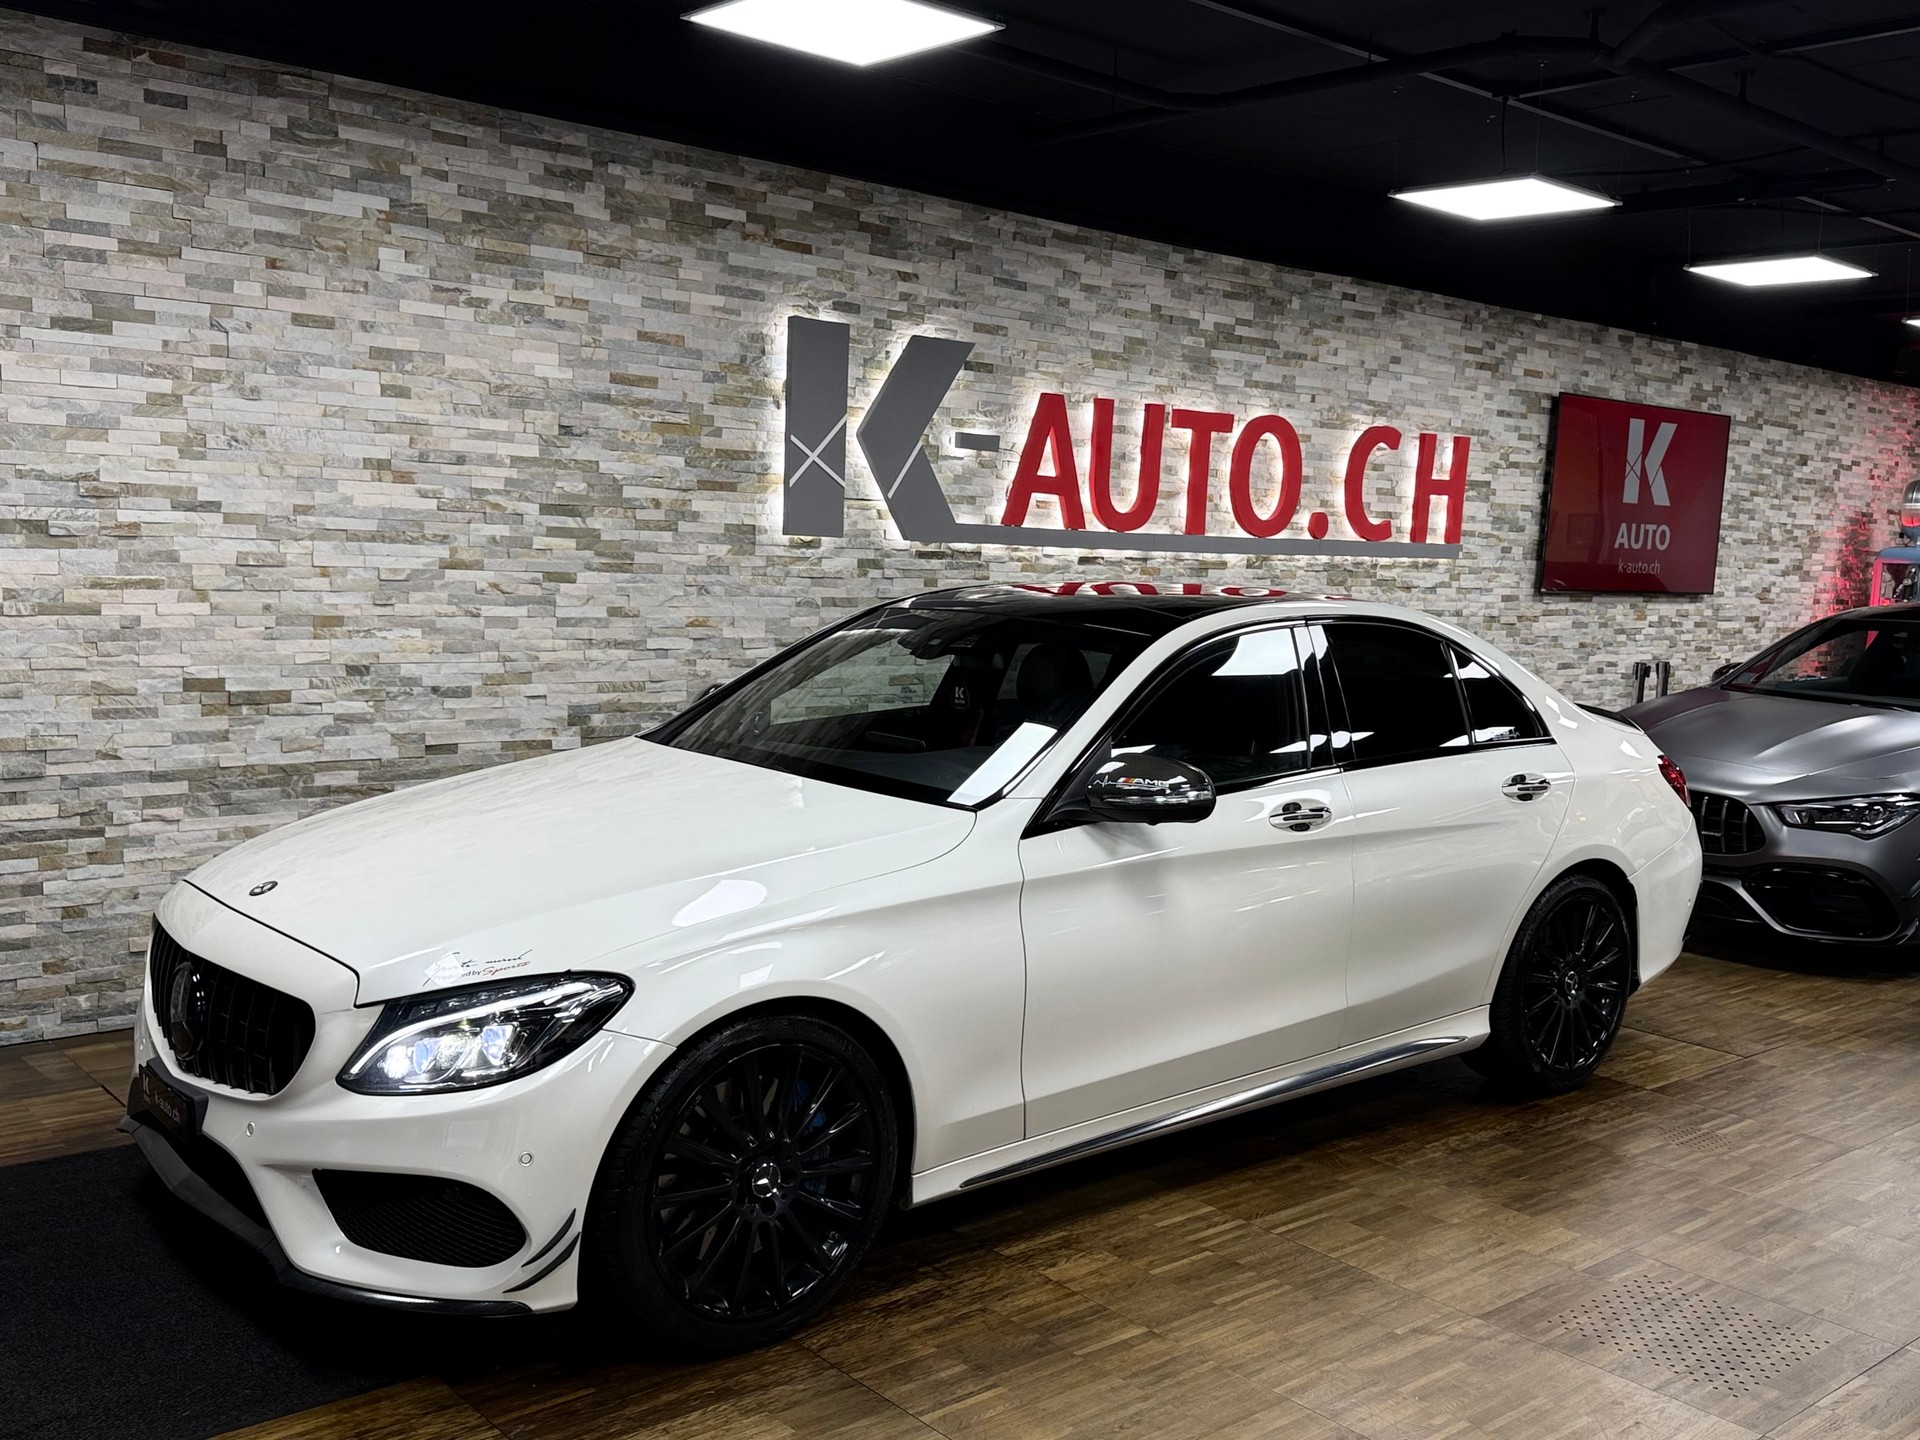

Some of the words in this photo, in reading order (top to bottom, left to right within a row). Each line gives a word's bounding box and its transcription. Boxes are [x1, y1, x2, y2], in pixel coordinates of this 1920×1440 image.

[1624, 418, 1677, 506] K
[1614, 522, 1671, 551] AUTO
[1618, 558, 1660, 575] k-auto.ch
